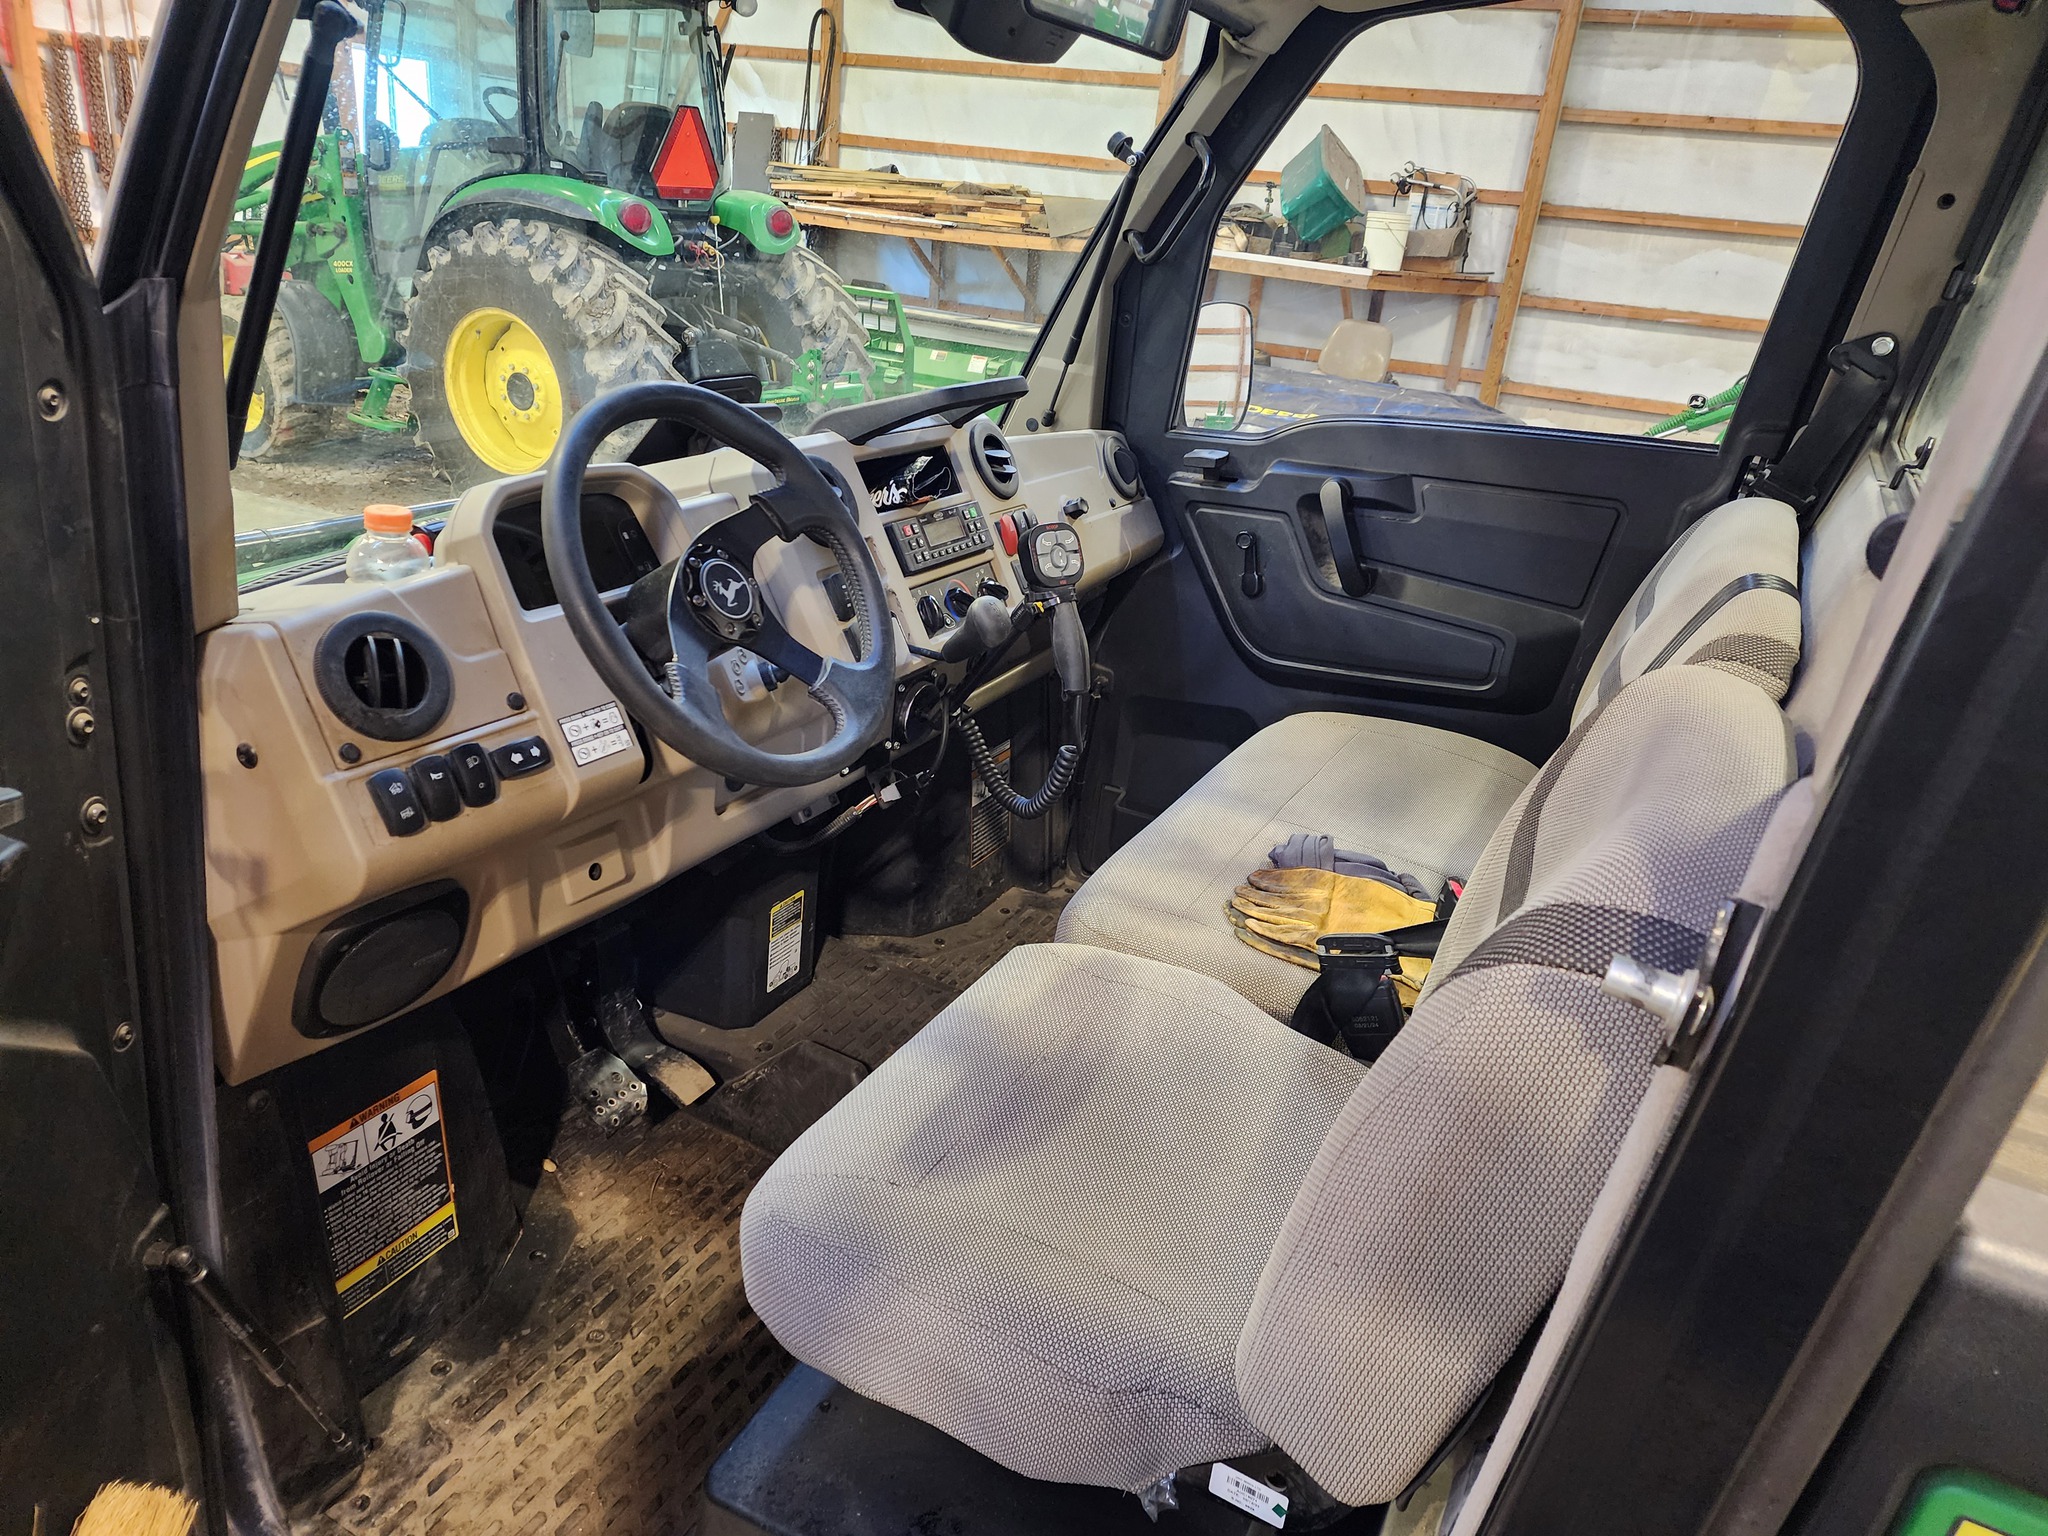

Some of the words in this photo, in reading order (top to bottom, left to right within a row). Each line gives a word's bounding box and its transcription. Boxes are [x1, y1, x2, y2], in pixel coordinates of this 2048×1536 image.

[359, 1093, 400, 1121] WARNING
[340, 1181, 356, 1197] from
[357, 1164, 384, 1186] Rollover
[386, 1160, 393, 1168] or
[393, 1144, 415, 1164] Falling
[416, 1138, 425, 1149] Off
[349, 1166, 368, 1183] Avoid
[369, 1154, 388, 1172] Injury
[389, 1150, 396, 1159] or
[397, 1137, 414, 1154] Death
[385, 1231, 418, 1258] CAUTION
